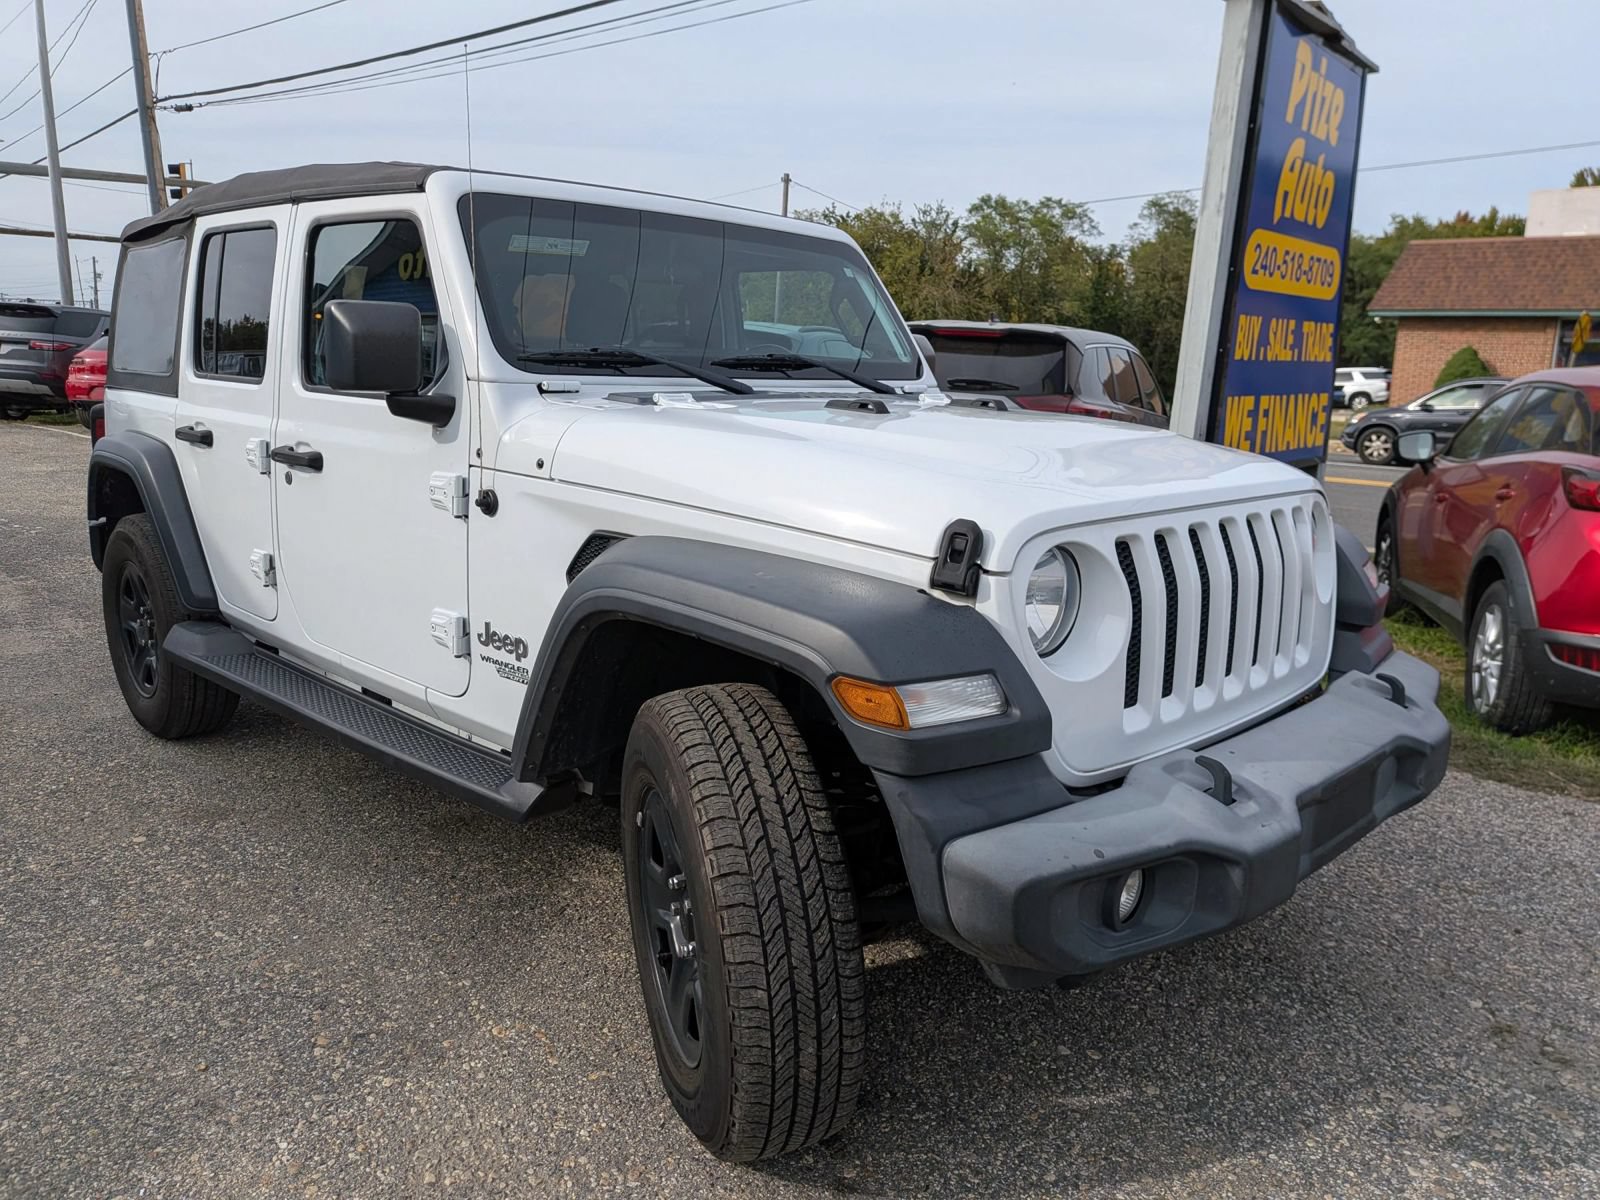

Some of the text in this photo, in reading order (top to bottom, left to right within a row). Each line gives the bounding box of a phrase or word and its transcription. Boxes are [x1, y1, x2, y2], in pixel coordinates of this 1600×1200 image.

[1285, 39, 1344, 147] Prize
[1273, 137, 1335, 230] Auto
[1251, 243, 1335, 288] 240-518-8709
[1234, 313, 1334, 362] BUY SALE TRADE
[1223, 393, 1329, 454] WE FINANCE
[477, 621, 529, 662] Jeep
[480, 653, 529, 675] WRANGLER
